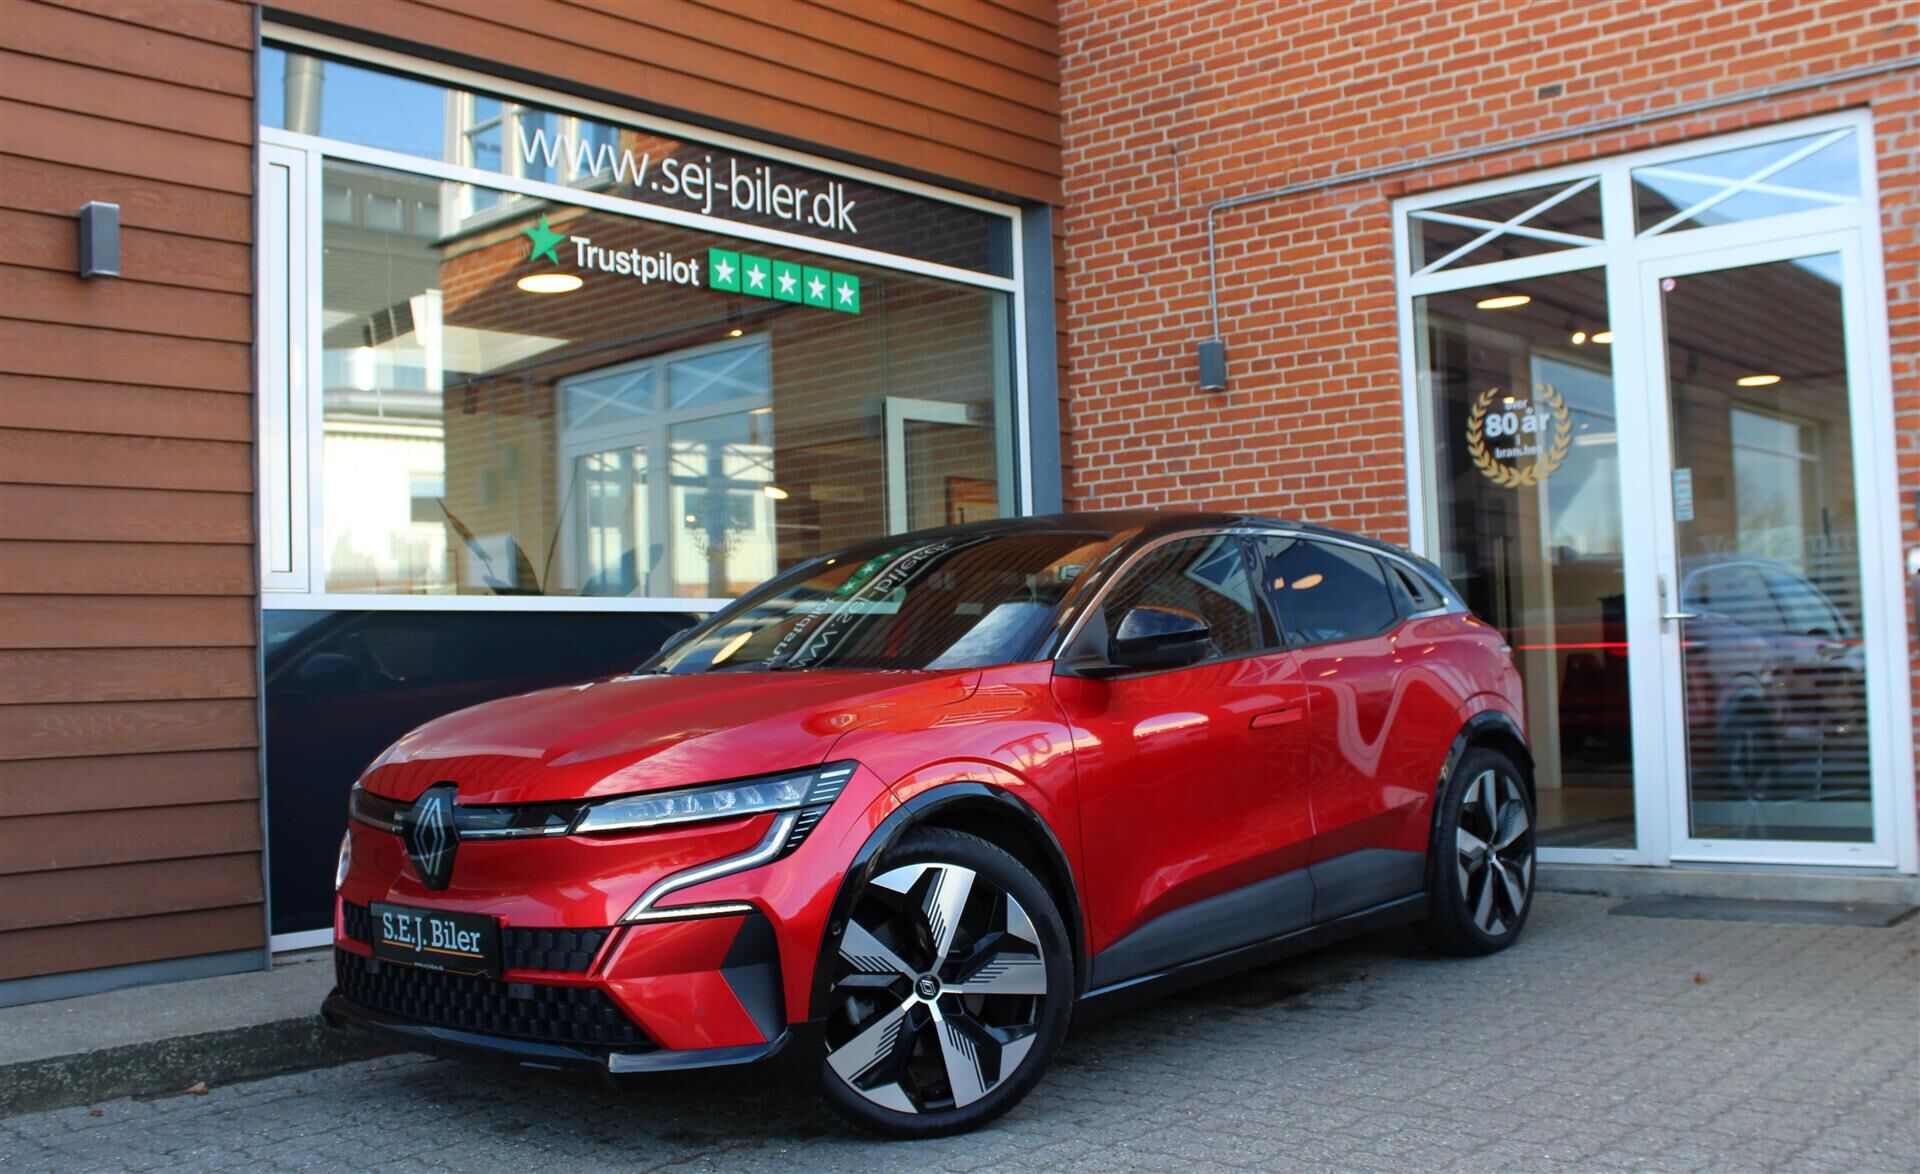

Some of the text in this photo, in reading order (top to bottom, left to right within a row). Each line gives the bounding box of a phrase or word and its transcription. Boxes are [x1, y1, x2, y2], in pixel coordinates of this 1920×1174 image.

[518, 124, 857, 233] www.sej-biler.dk
[570, 236, 699, 286] Trustpilot
[1485, 407, 1551, 437] 80 år
[383, 912, 481, 953] S.E.J. Biler
